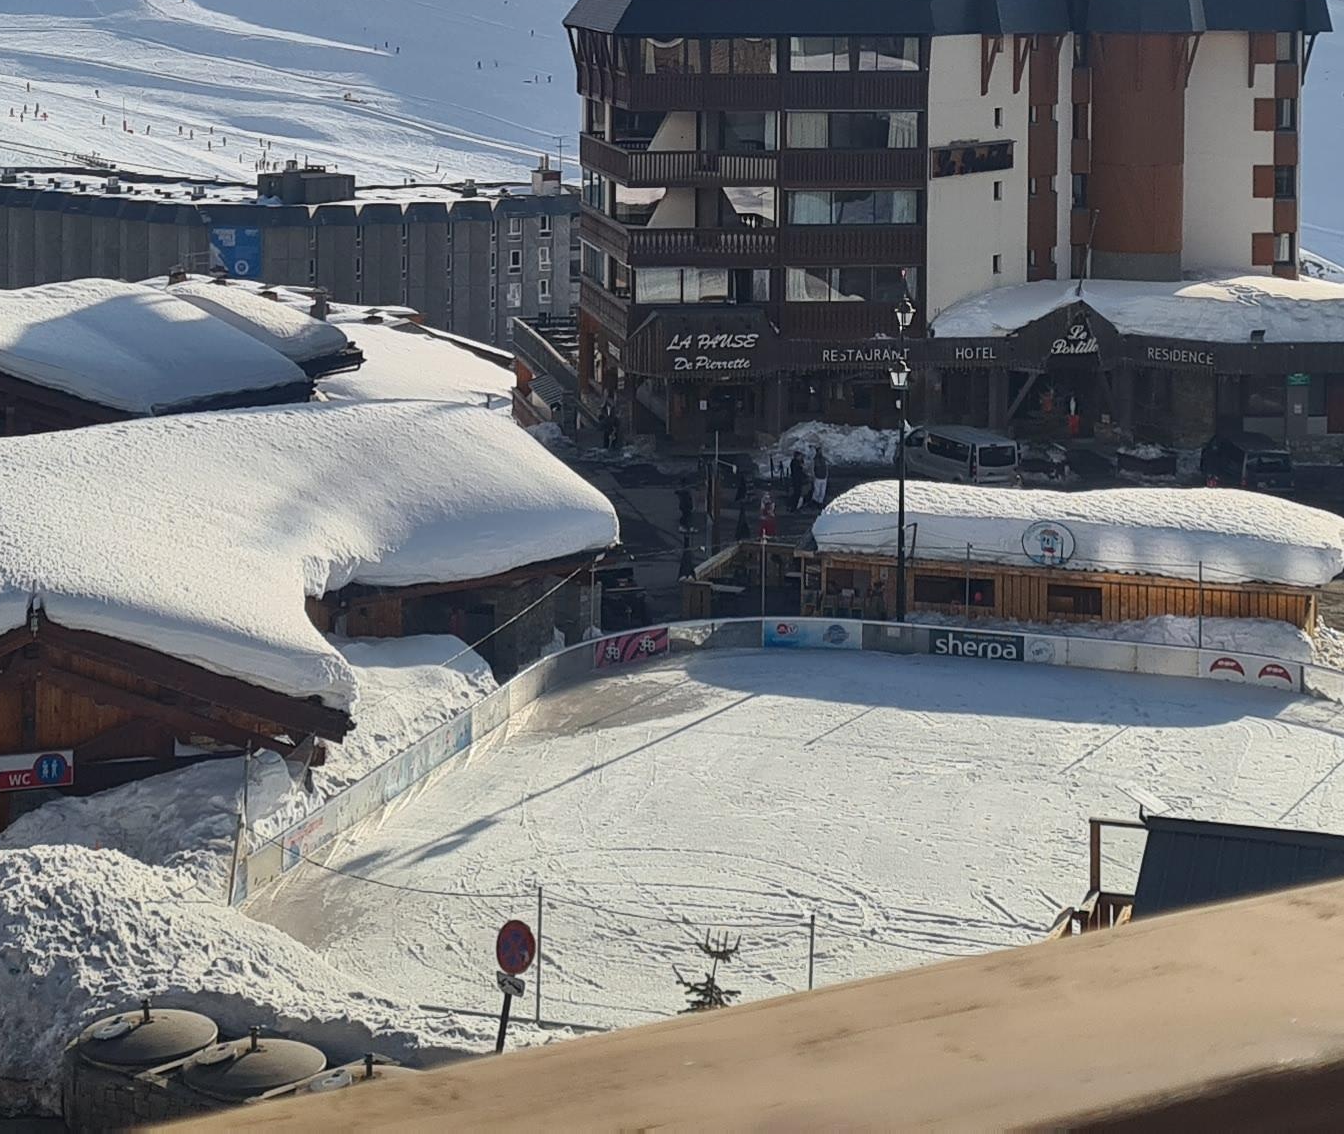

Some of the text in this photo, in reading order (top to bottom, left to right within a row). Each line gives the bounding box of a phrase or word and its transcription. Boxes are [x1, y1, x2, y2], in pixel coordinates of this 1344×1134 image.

[1067, 324, 1087, 340] Le
[666, 333, 759, 351] LA PAUSE
[955, 347, 997, 360] HOTEL
[1147, 347, 1214, 365] RESIDENCE
[674, 356, 751, 370] De Pierrette
[935, 632, 1017, 660] sherpa
[8, 773, 31, 786] WC
